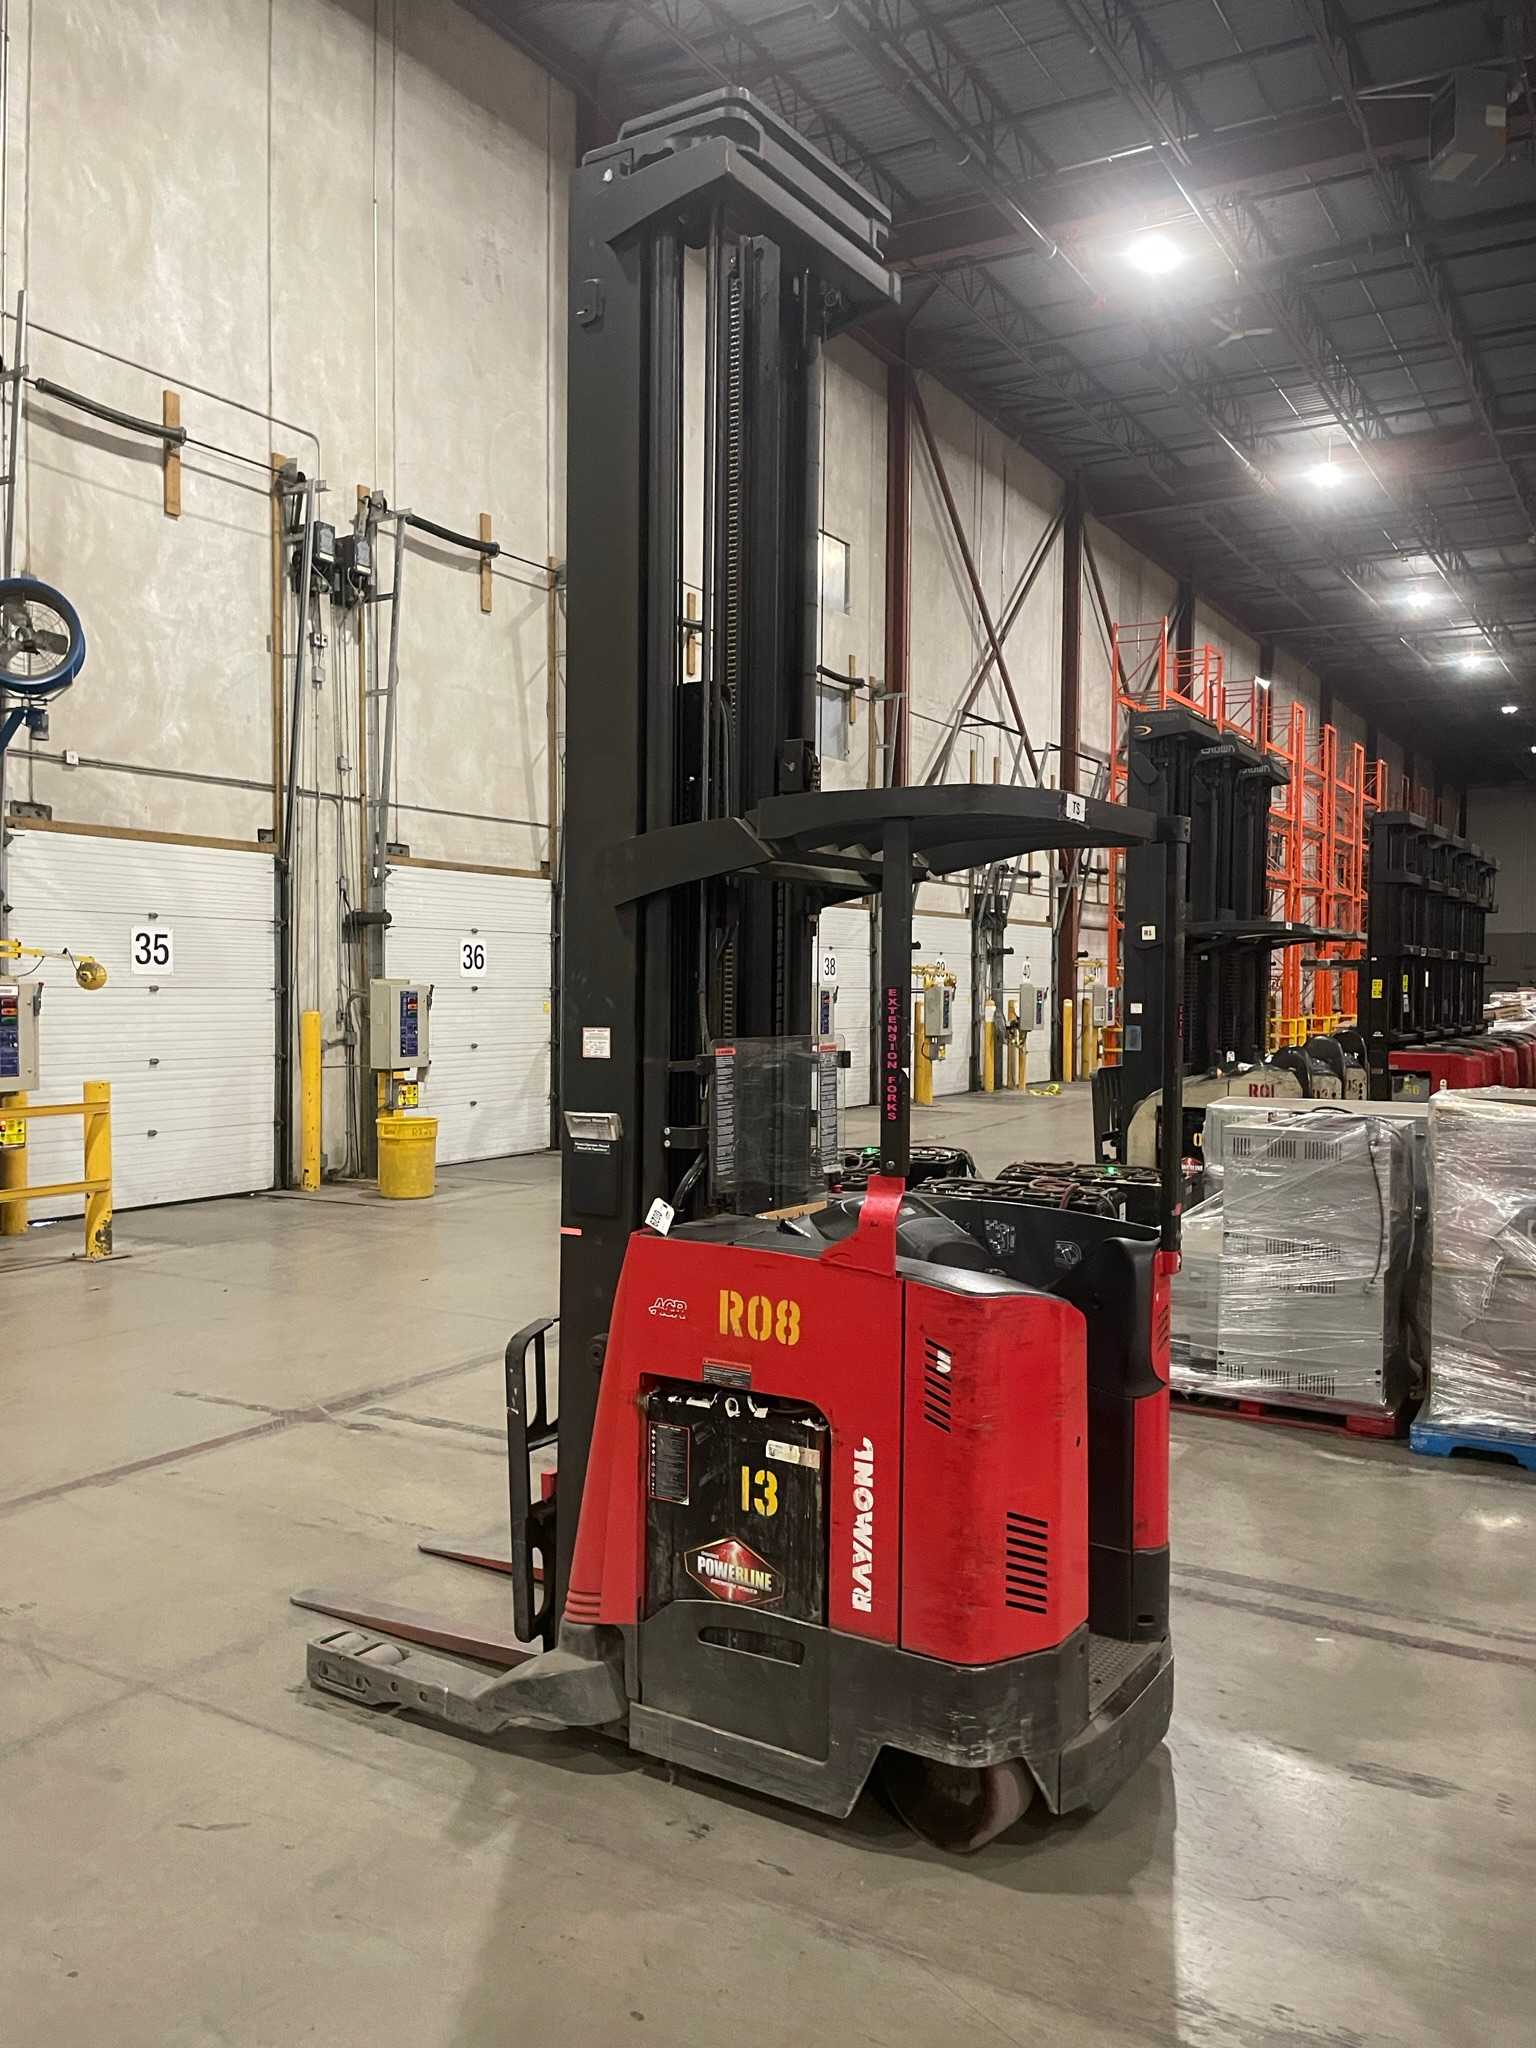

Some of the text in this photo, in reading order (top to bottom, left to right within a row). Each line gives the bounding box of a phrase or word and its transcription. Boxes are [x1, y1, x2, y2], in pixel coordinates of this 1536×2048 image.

[135, 932, 169, 965] 35
[463, 944, 485, 970] 36
[824, 957, 836, 976] 38
[886, 988, 898, 1121] EXTENSION FORKS
[719, 1289, 801, 1346] R08
[741, 1465, 779, 1517] 13
[697, 1555, 773, 1593] POWERLINE
